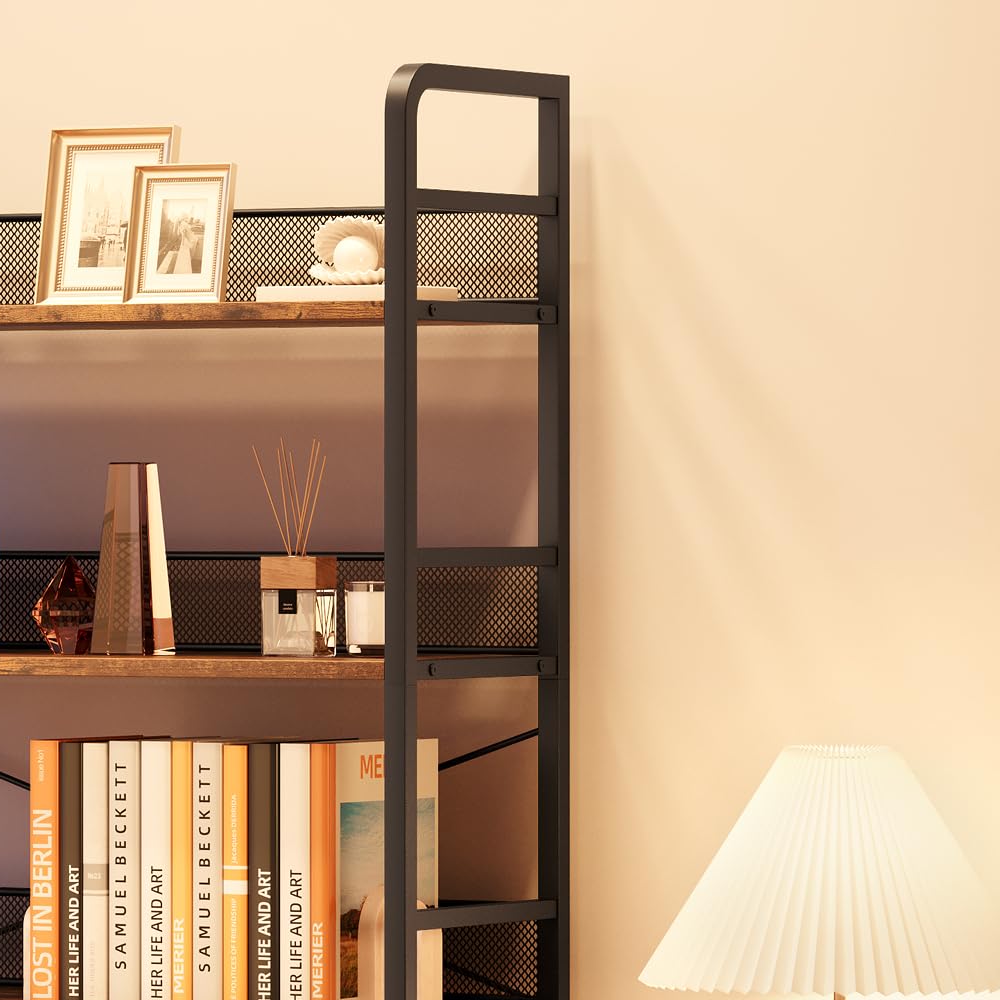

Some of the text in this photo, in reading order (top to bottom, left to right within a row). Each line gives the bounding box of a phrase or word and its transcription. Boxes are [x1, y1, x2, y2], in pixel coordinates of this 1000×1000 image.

[360, 754, 385, 779] ME
[115, 763, 126, 969] SAMUEL BECKETT
[199, 765, 210, 972] SAMUEL BECKETT
[258, 869, 271, 898] ART
[290, 870, 302, 899] ART
[33, 809, 52, 999] LOST IN BERLIN
[69, 865, 79, 996] HER LIFE AND ART
[258, 902, 271, 936] AND
[290, 902, 302, 937] AND
[151, 866, 163, 998] HER LIFE AND ART
[174, 919, 184, 993] MERIER
[258, 939, 271, 967] LIFE
[290, 940, 302, 971] LIFE
[313, 923, 323, 999] MERIER
